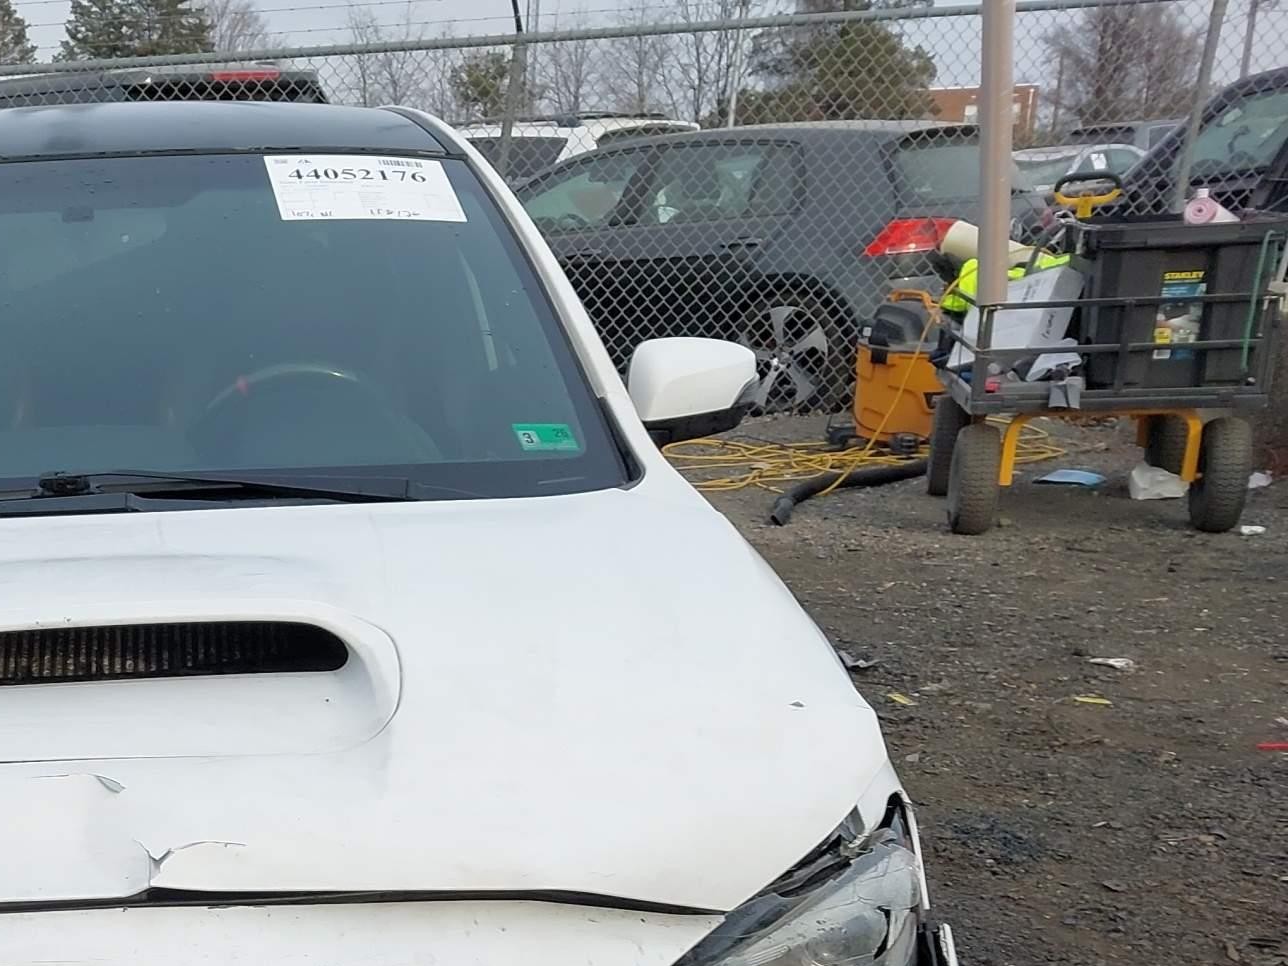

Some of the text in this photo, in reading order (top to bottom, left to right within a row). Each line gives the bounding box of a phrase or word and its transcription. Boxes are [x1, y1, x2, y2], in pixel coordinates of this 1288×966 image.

[288, 167, 427, 183] 44052176
[1163, 271, 1205, 280] STANLEY
[522, 432, 534, 444] 3
